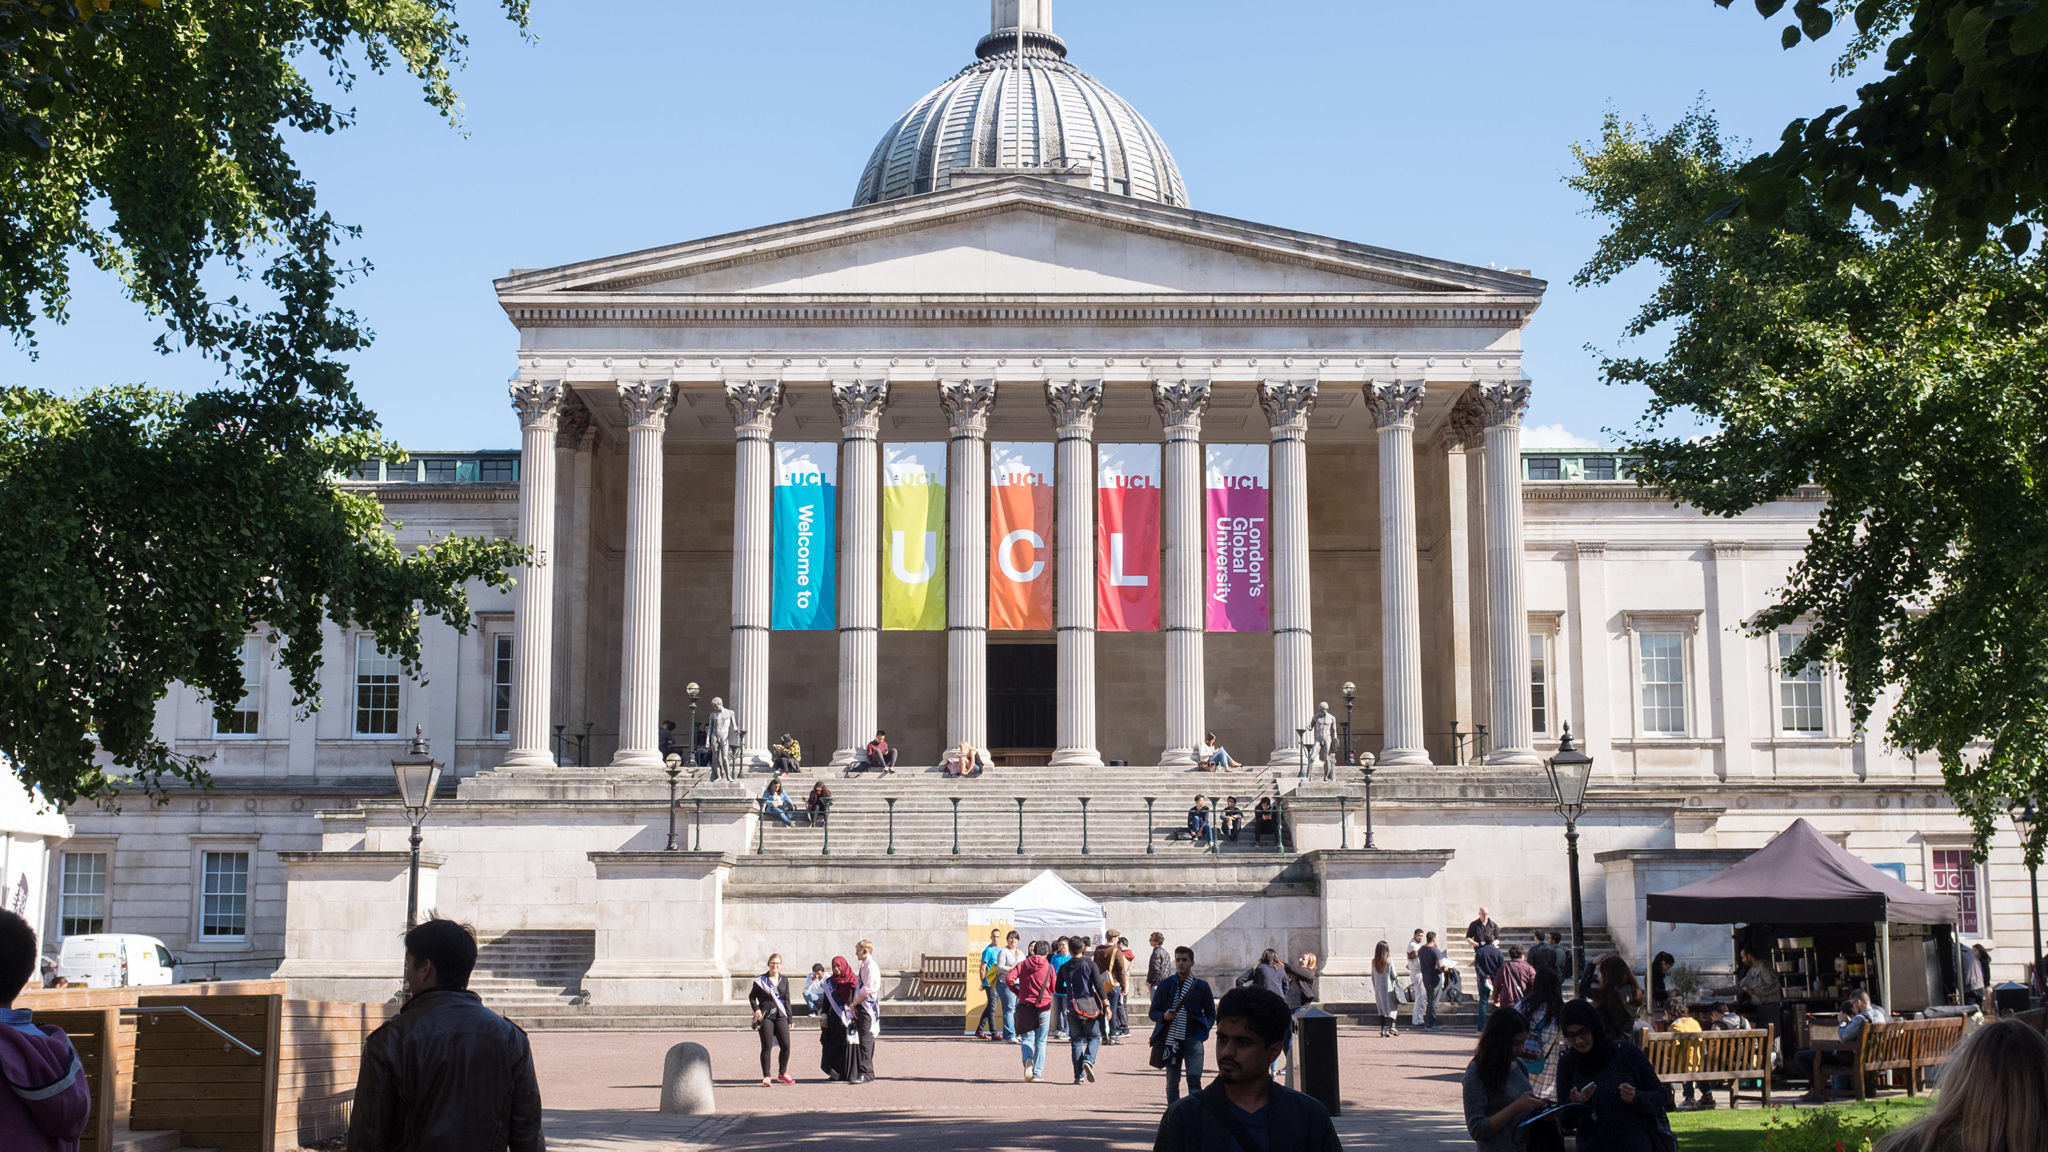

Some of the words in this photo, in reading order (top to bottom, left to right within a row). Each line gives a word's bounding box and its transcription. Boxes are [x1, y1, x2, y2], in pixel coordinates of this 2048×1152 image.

[791, 472, 831, 487] UCL
[901, 473, 941, 488] UCL
[1009, 472, 1049, 488] UCL
[1115, 475, 1155, 490] UCL
[1223, 475, 1264, 491] UCL
[797, 504, 814, 586] Welcome
[891, 530, 937, 584] U
[998, 529, 1045, 582] C
[1110, 533, 1148, 586] L
[1214, 517, 1232, 603] University
[1232, 517, 1248, 573] Global
[1249, 517, 1264, 597] London's
[797, 591, 812, 609] to
[1935, 873, 1974, 888] UCL
